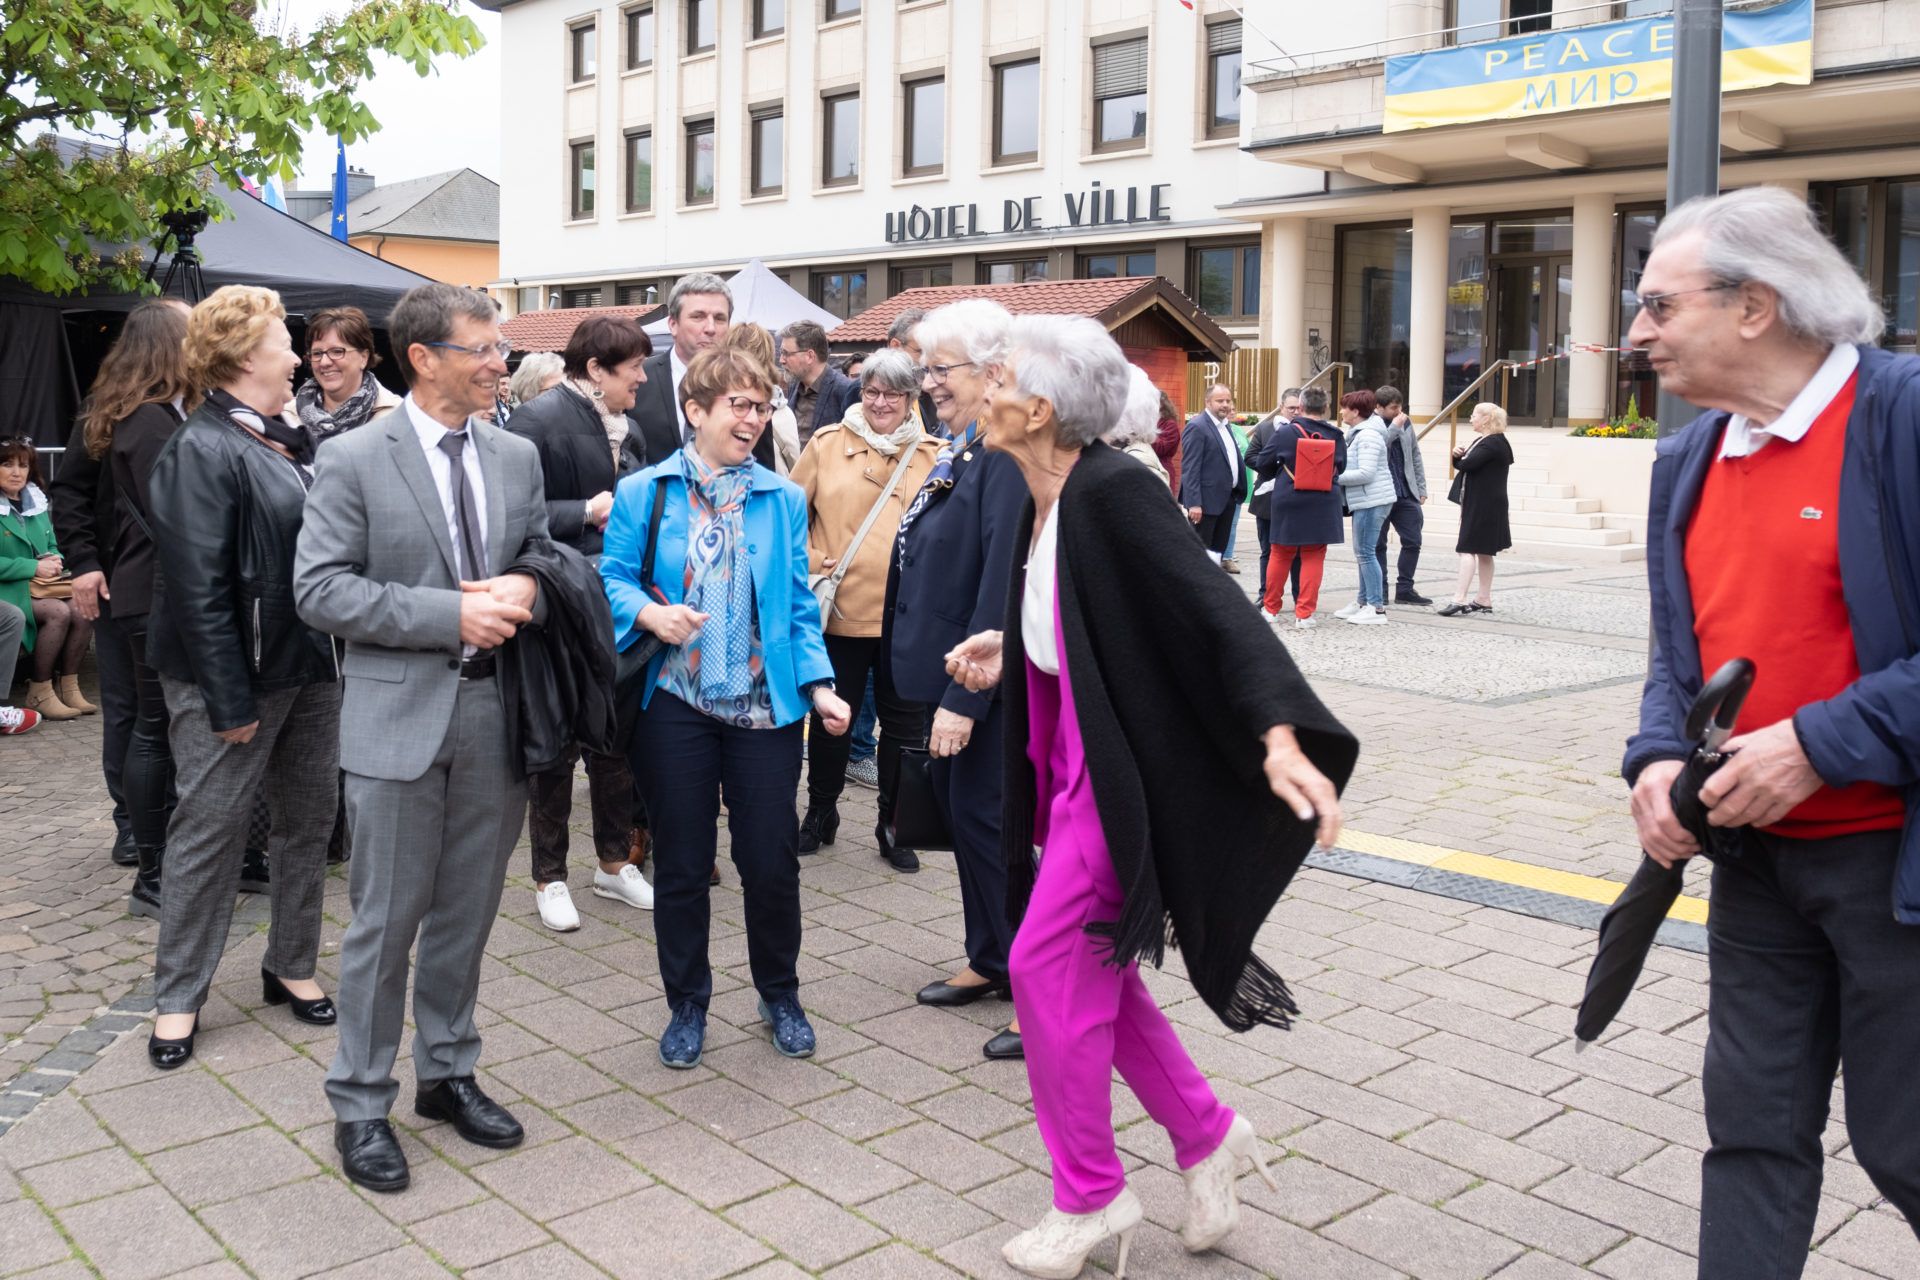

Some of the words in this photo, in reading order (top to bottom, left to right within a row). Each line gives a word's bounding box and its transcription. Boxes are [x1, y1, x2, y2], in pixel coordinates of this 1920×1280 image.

[1484, 24, 1675, 76] PEACE
[885, 203, 985, 243] HÔTEL
[1004, 196, 1042, 232] DE
